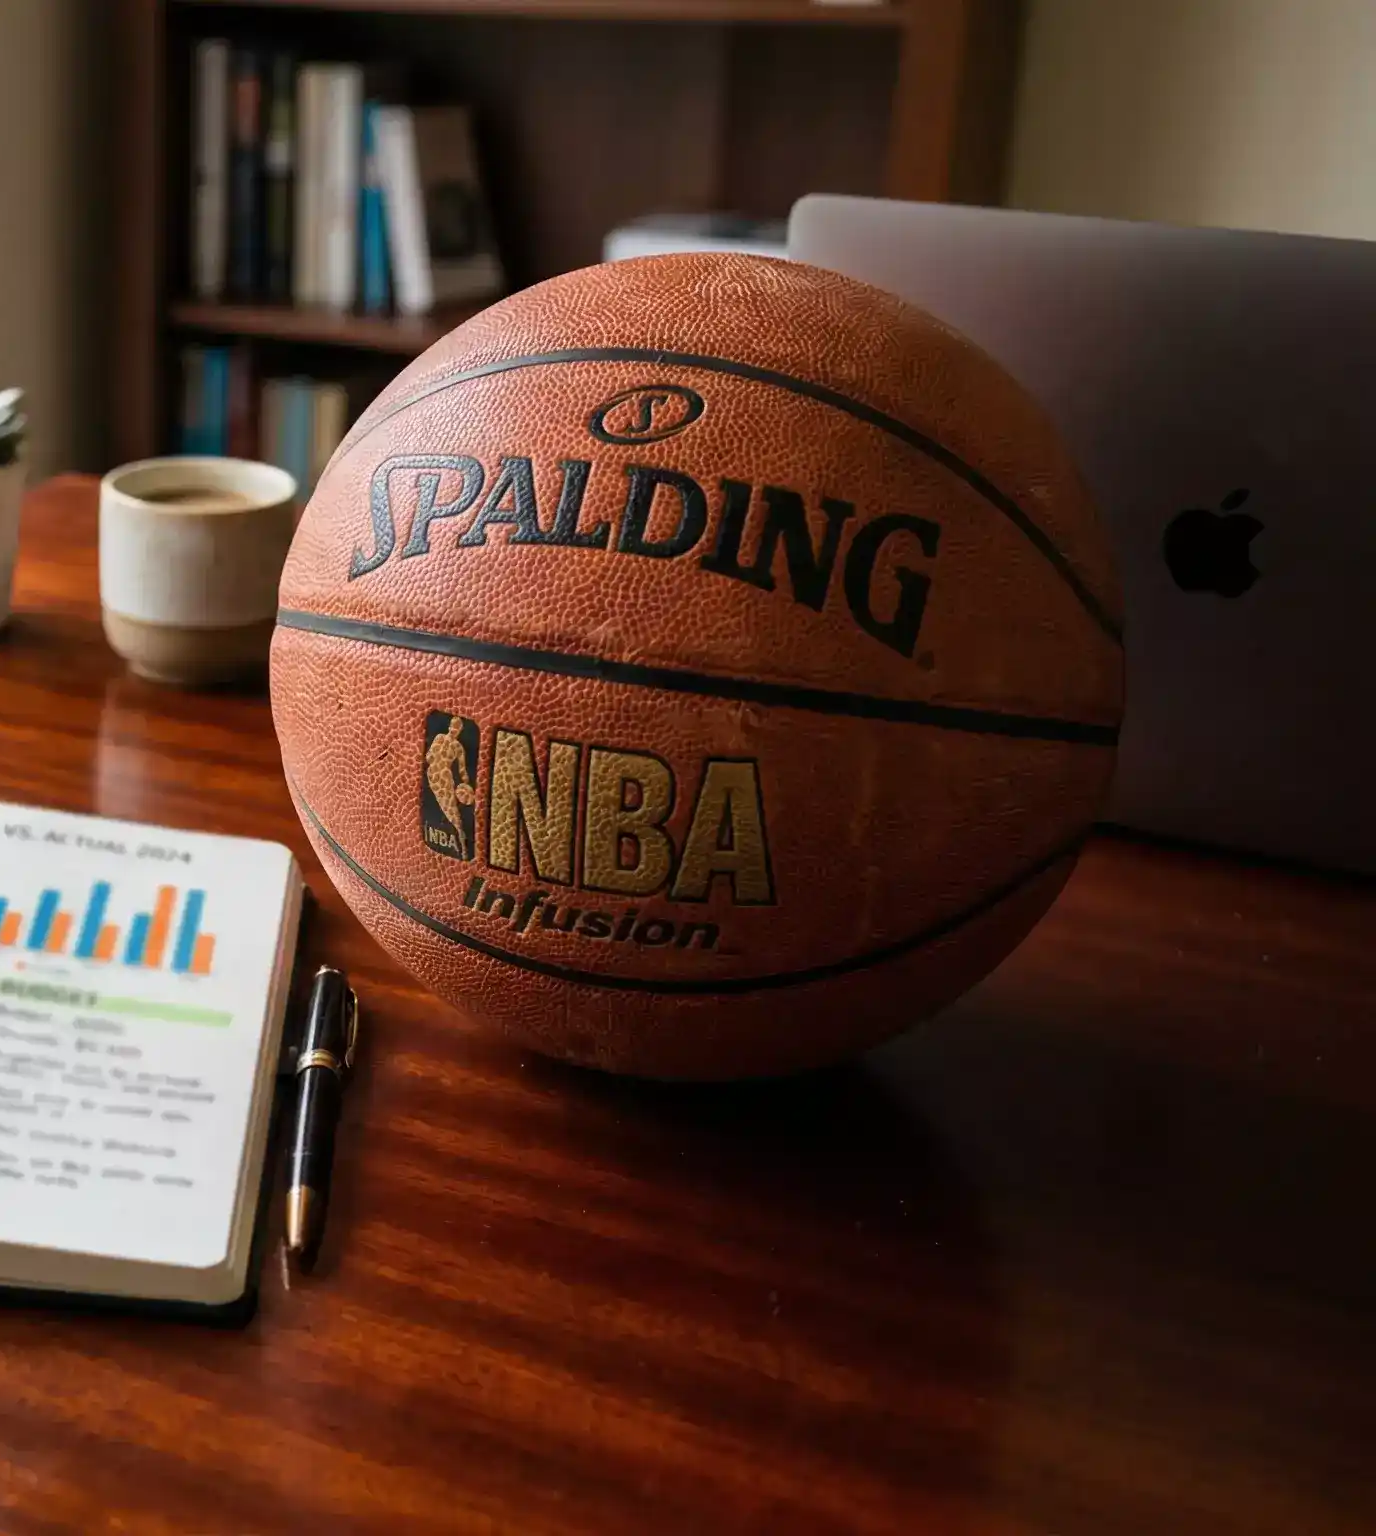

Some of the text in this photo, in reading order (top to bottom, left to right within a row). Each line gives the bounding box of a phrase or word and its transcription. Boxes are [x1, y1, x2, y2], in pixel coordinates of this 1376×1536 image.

[347, 452, 942, 660] SPALDING
[43, 828, 128, 856] ACTUAL
[428, 826, 460, 855] NBA
[486, 727, 778, 906] NBA
[463, 876, 720, 950] Infusion
